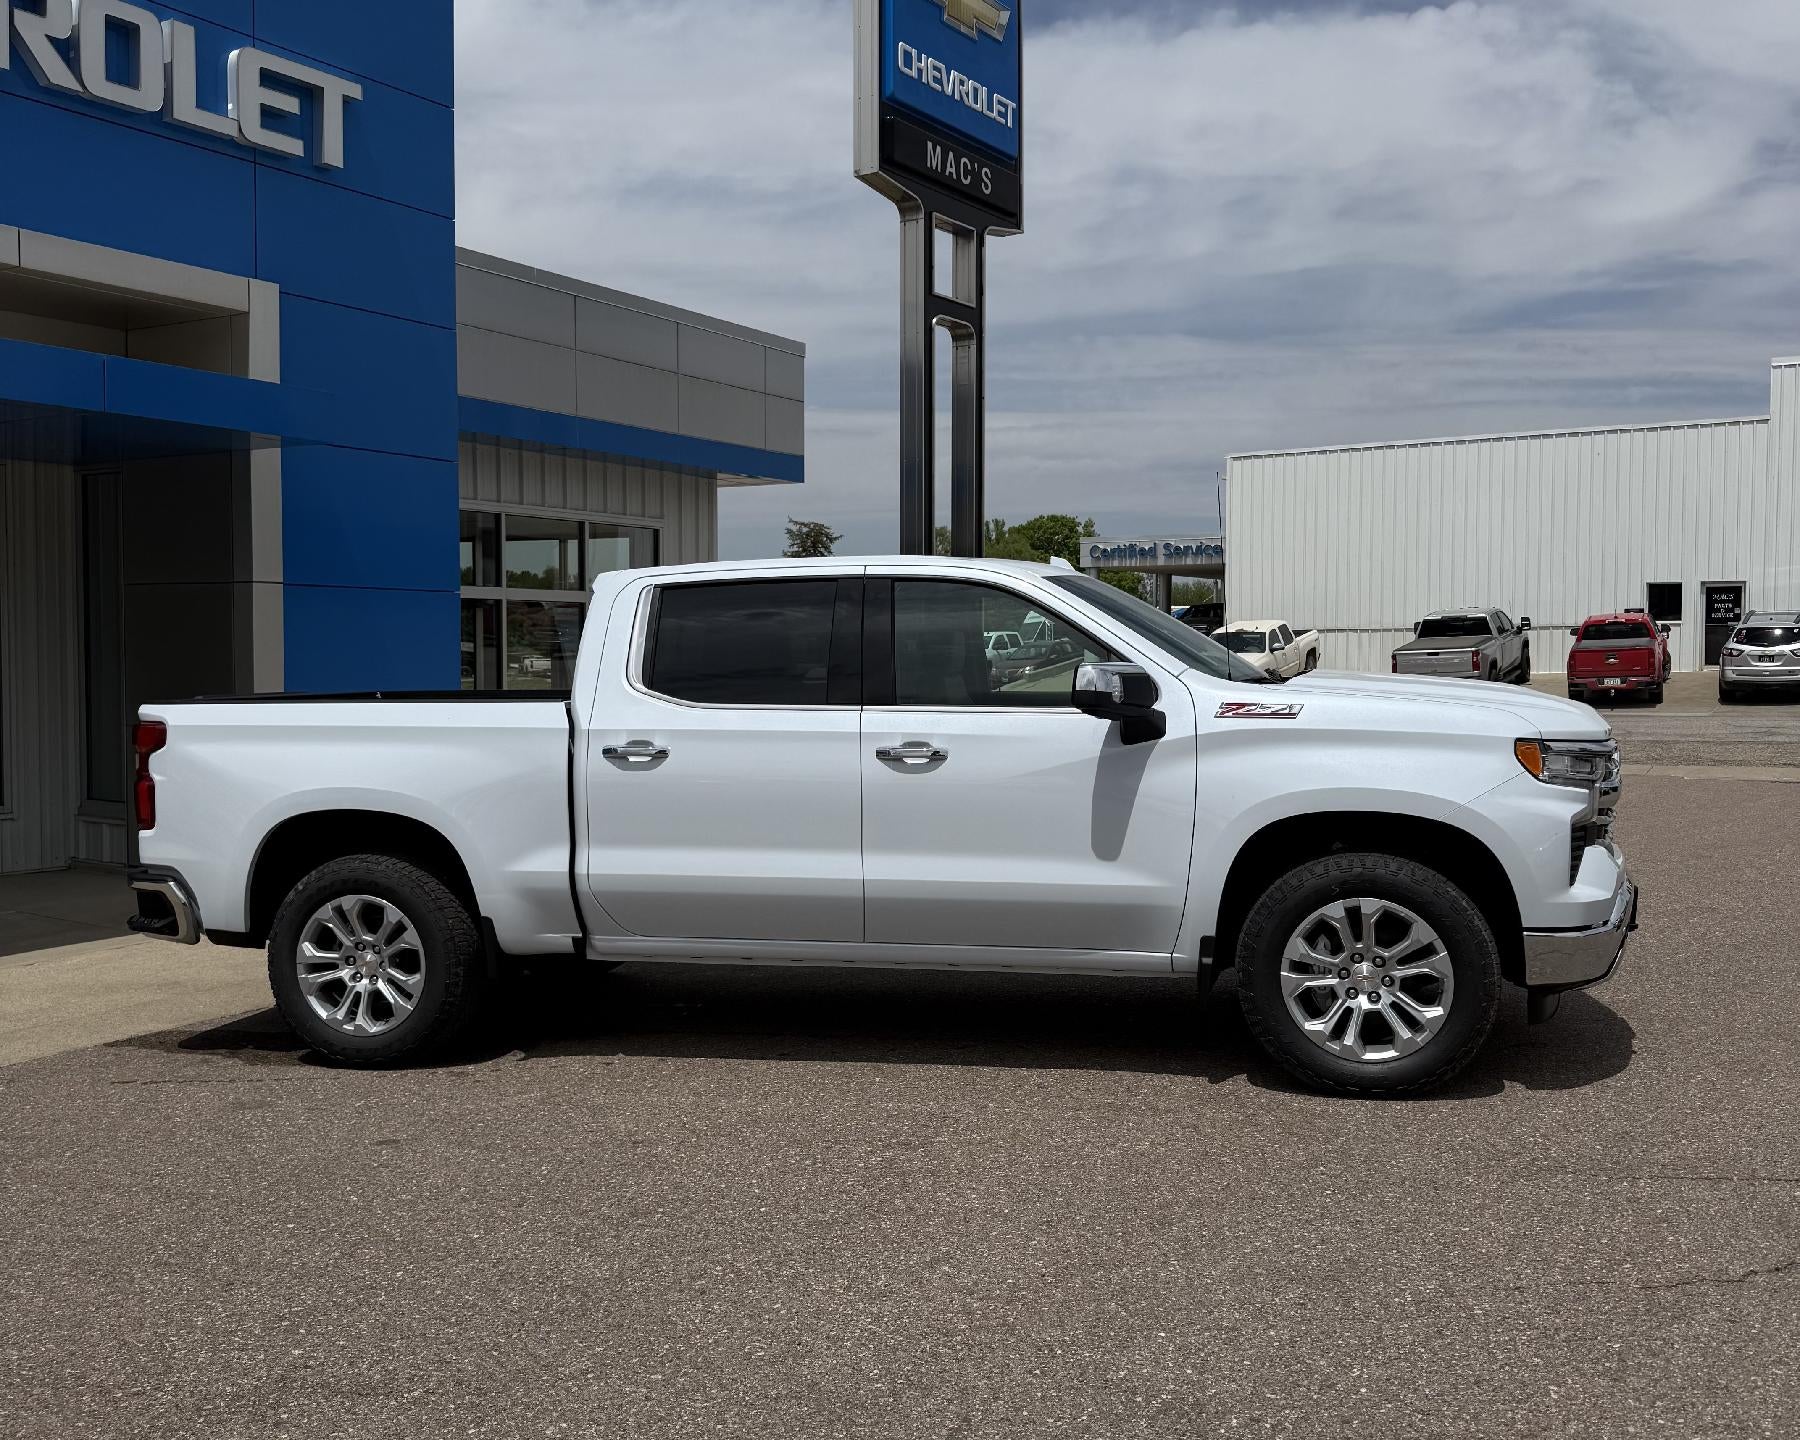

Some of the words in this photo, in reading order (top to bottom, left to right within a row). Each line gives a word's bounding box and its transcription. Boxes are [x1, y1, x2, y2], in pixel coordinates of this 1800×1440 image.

[899, 41, 1017, 129] CHEVROLET
[926, 140, 992, 195] MAC'S
[1089, 542, 1157, 561] Certified
[1163, 542, 1223, 558] Service
[1214, 702, 1305, 719] Z71
